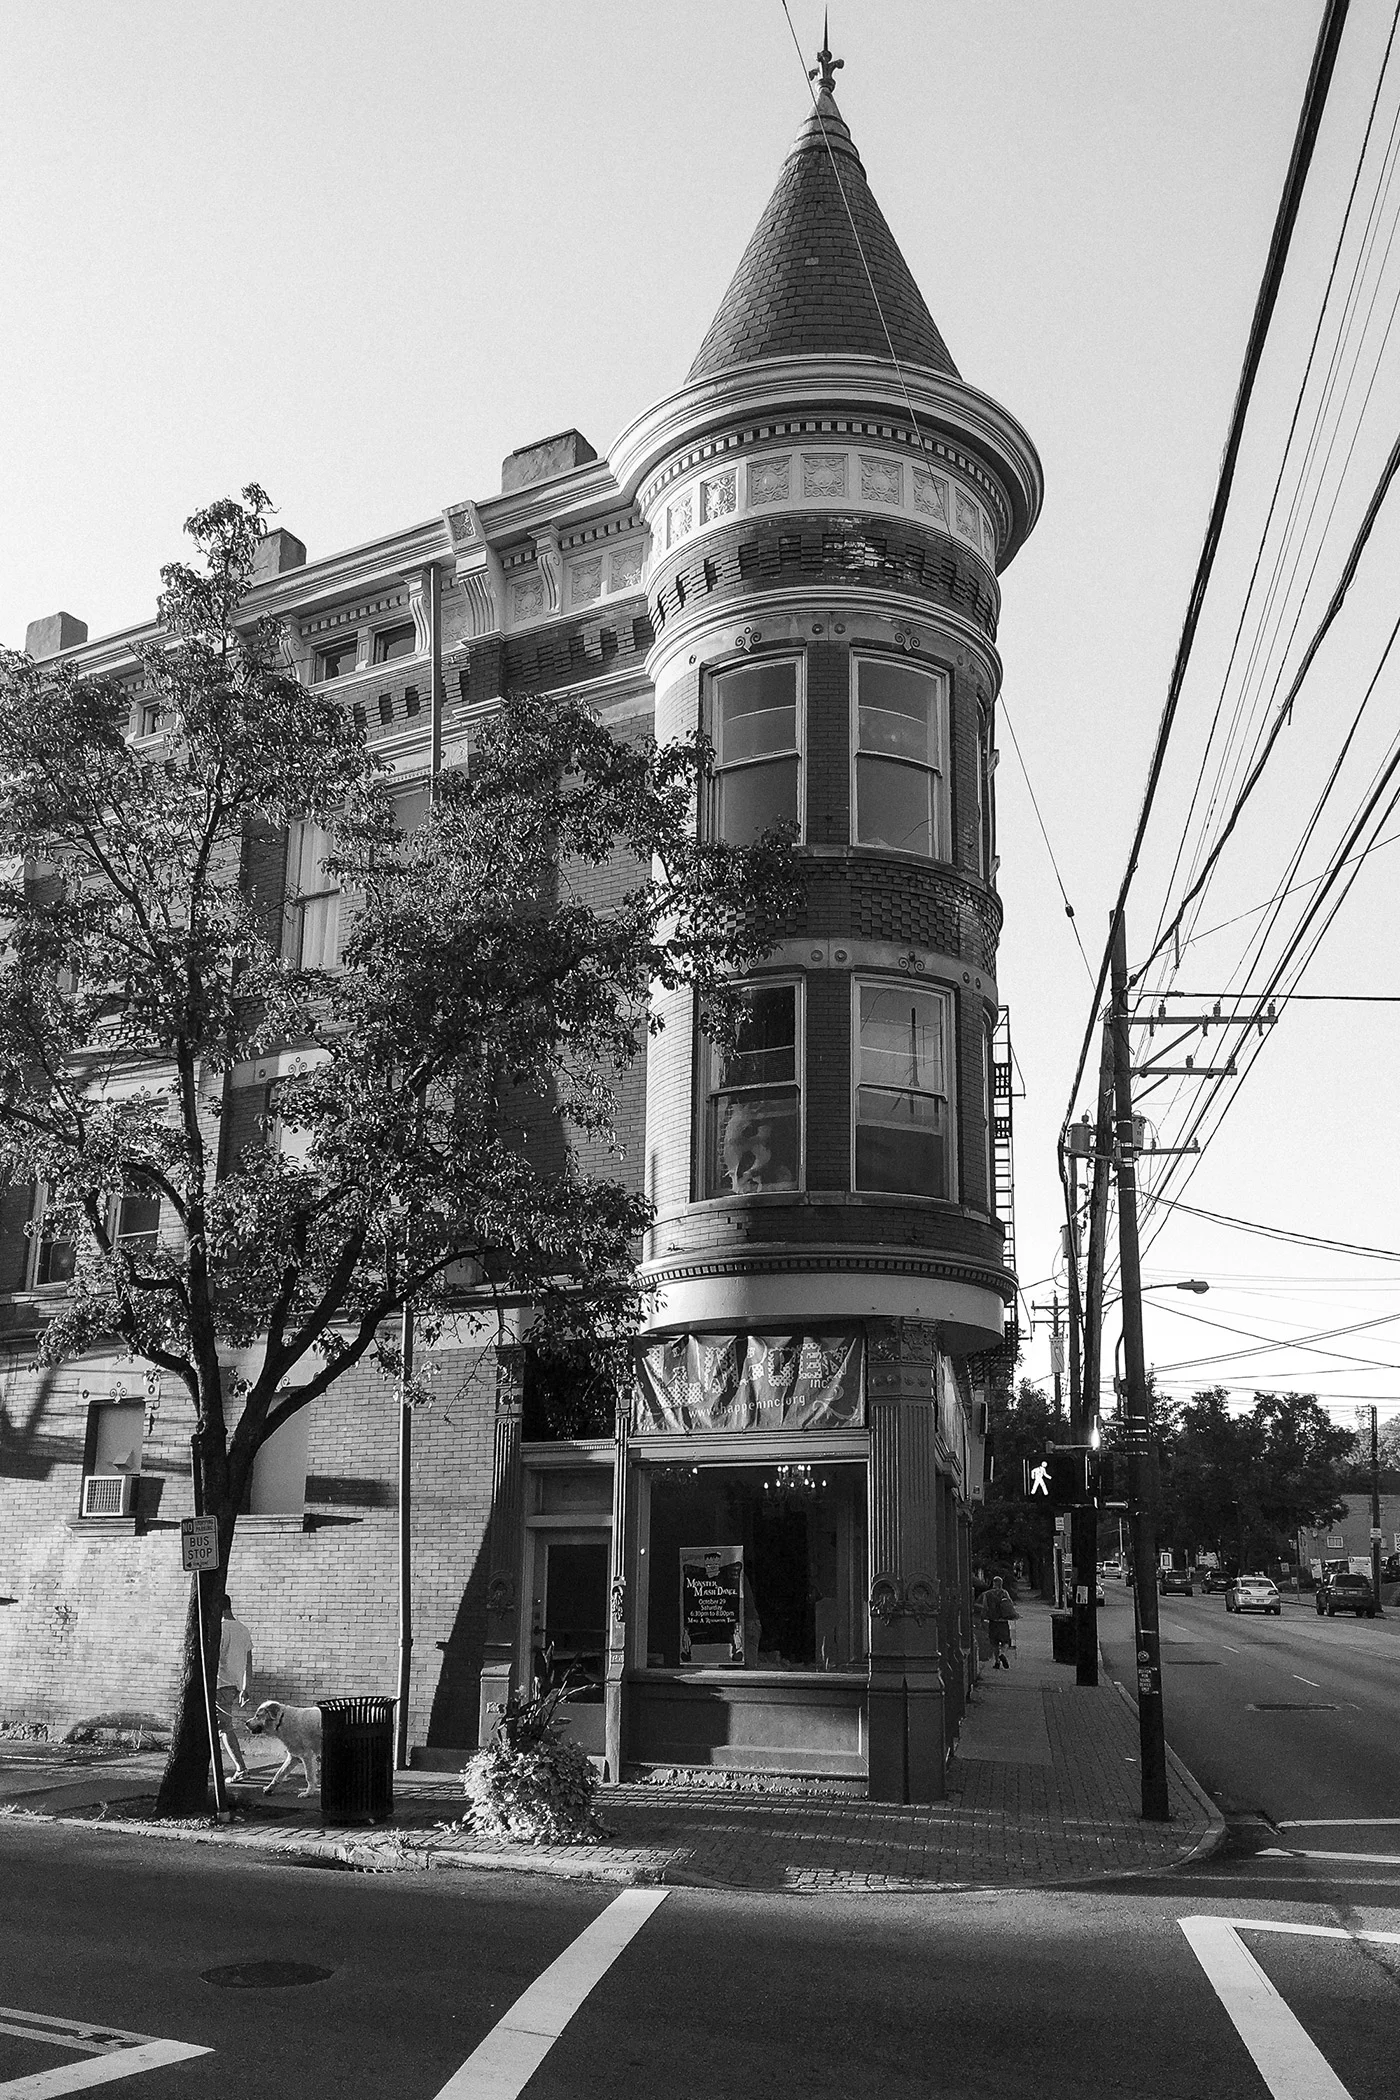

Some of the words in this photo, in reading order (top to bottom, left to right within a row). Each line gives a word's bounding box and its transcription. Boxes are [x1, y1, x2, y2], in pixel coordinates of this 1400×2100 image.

[182, 1522, 193, 1533] NO
[190, 1536, 209, 1547] BUS
[188, 1548, 212, 1560] STOP
[694, 1586, 716, 1597] MASH
